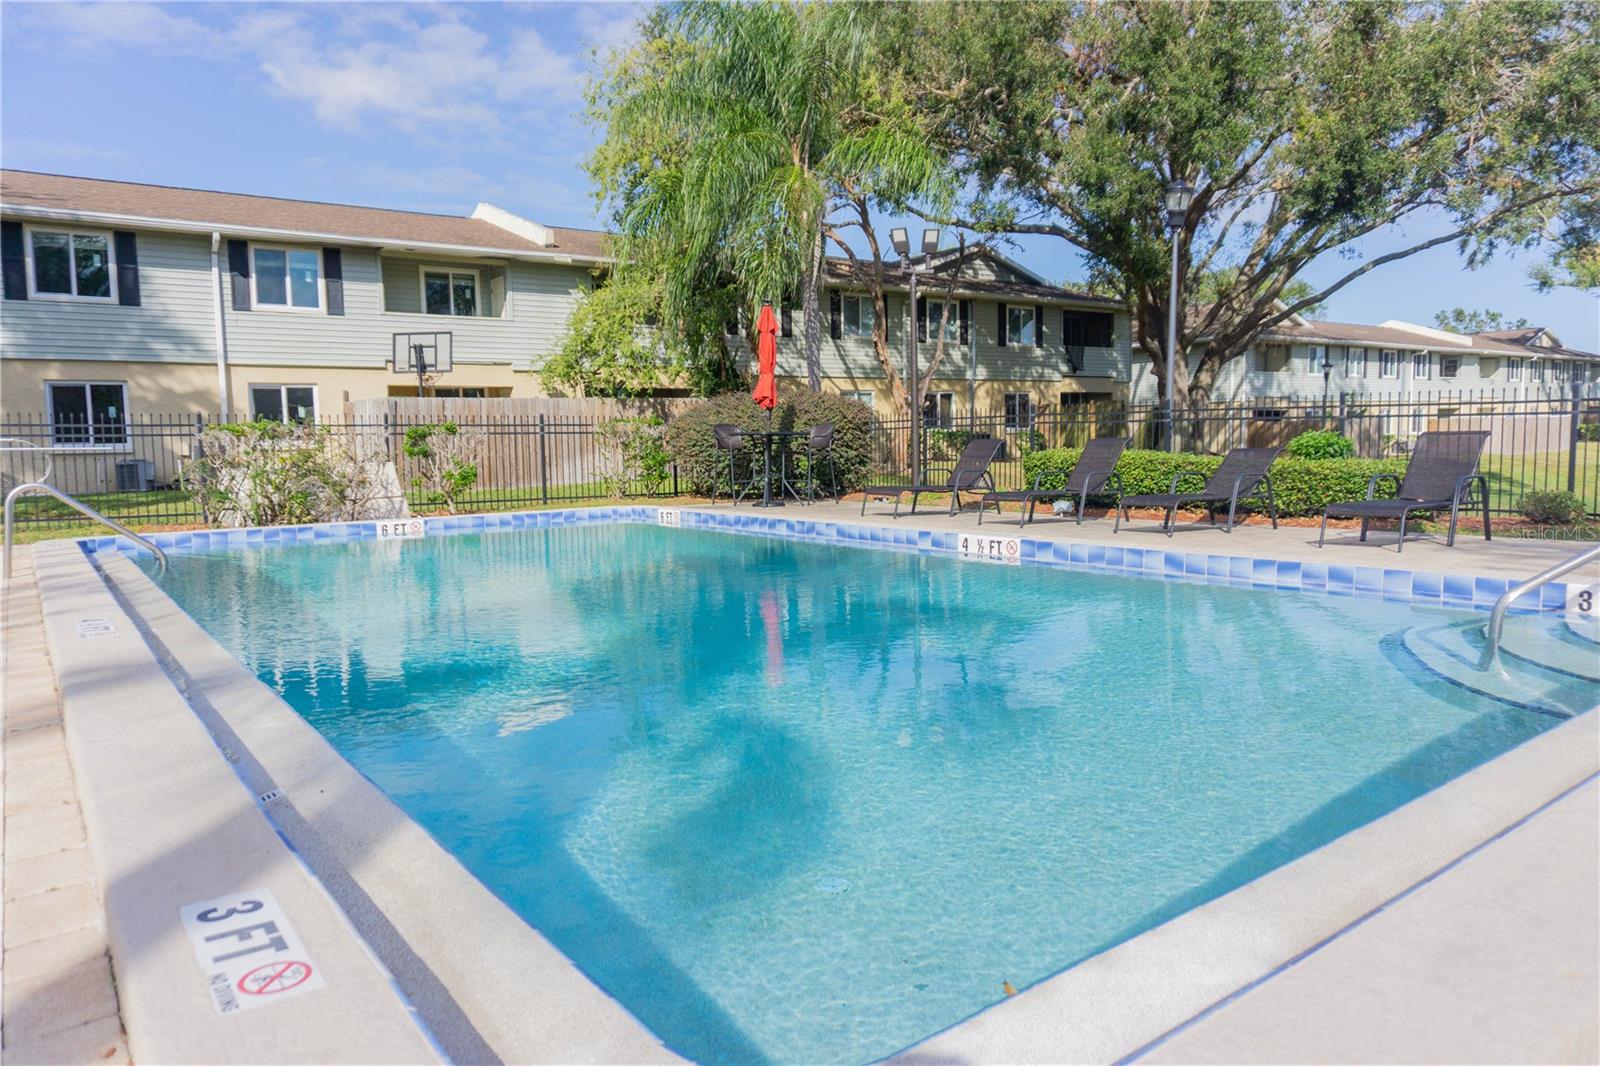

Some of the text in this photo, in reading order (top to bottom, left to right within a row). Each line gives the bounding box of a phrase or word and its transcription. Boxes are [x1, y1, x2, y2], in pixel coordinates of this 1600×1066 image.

[381, 524, 389, 537] 6
[962, 537, 969, 552] 4
[1578, 590, 1593, 612] 3
[195, 900, 289, 963] 3 FT
[208, 972, 240, 1013] NO DIVING
